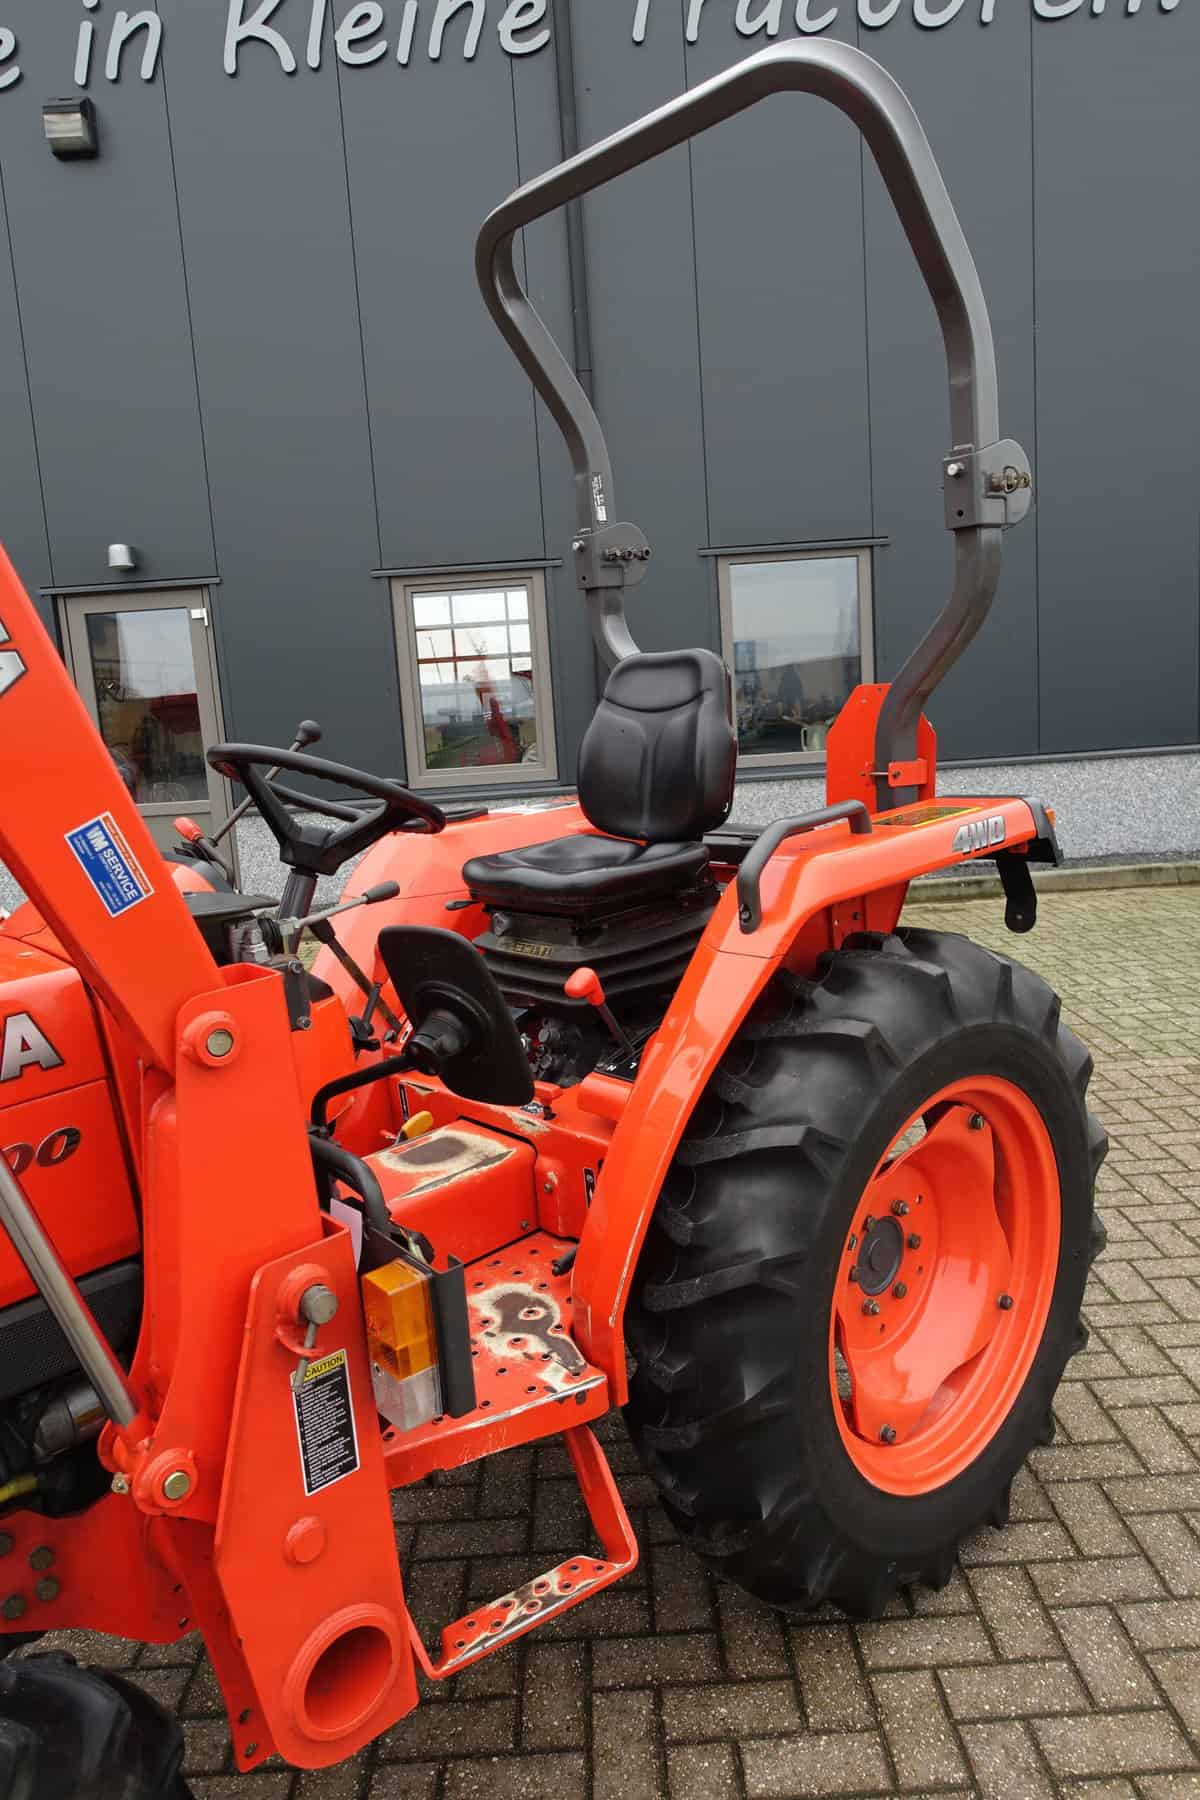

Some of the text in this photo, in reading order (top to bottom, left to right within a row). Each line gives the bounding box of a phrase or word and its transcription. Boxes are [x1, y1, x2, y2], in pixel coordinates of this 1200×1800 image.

[73, 0, 163, 87] in
[223, 0, 551, 76] Kleine
[952, 816, 1006, 854] 4WD
[103, 848, 138, 900] SERVICE
[304, 1354, 343, 1378] CAUTION
